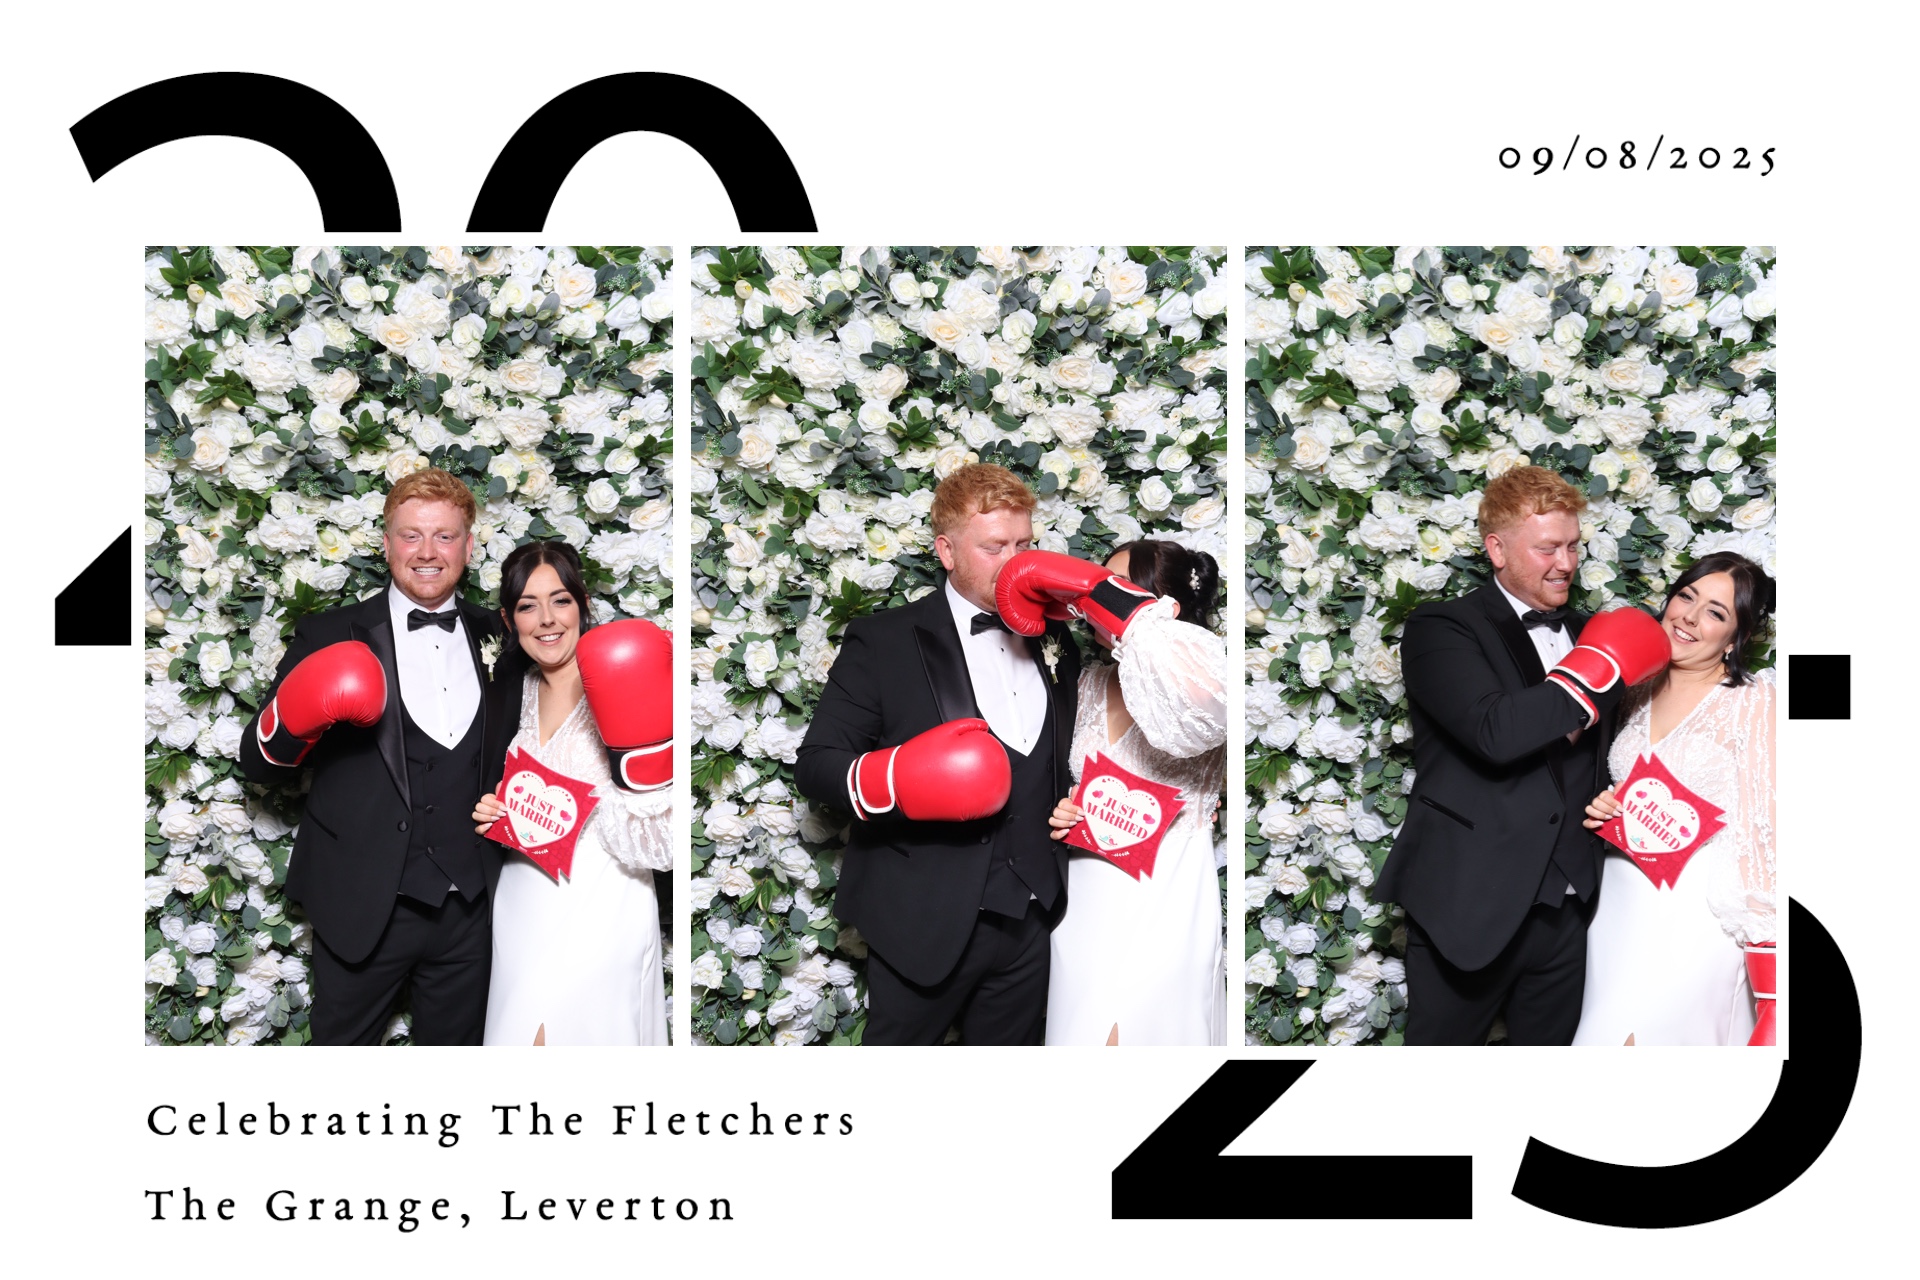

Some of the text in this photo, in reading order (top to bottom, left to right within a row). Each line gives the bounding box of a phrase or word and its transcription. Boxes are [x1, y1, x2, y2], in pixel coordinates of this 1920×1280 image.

[507, 797, 565, 837] MARRIED
[523, 792, 556, 815] JUST
[1103, 796, 1139, 819] JUST
[1643, 800, 1677, 827] JUST
[1084, 802, 1148, 839] MARRIED
[1623, 800, 1681, 850] MARRIED
